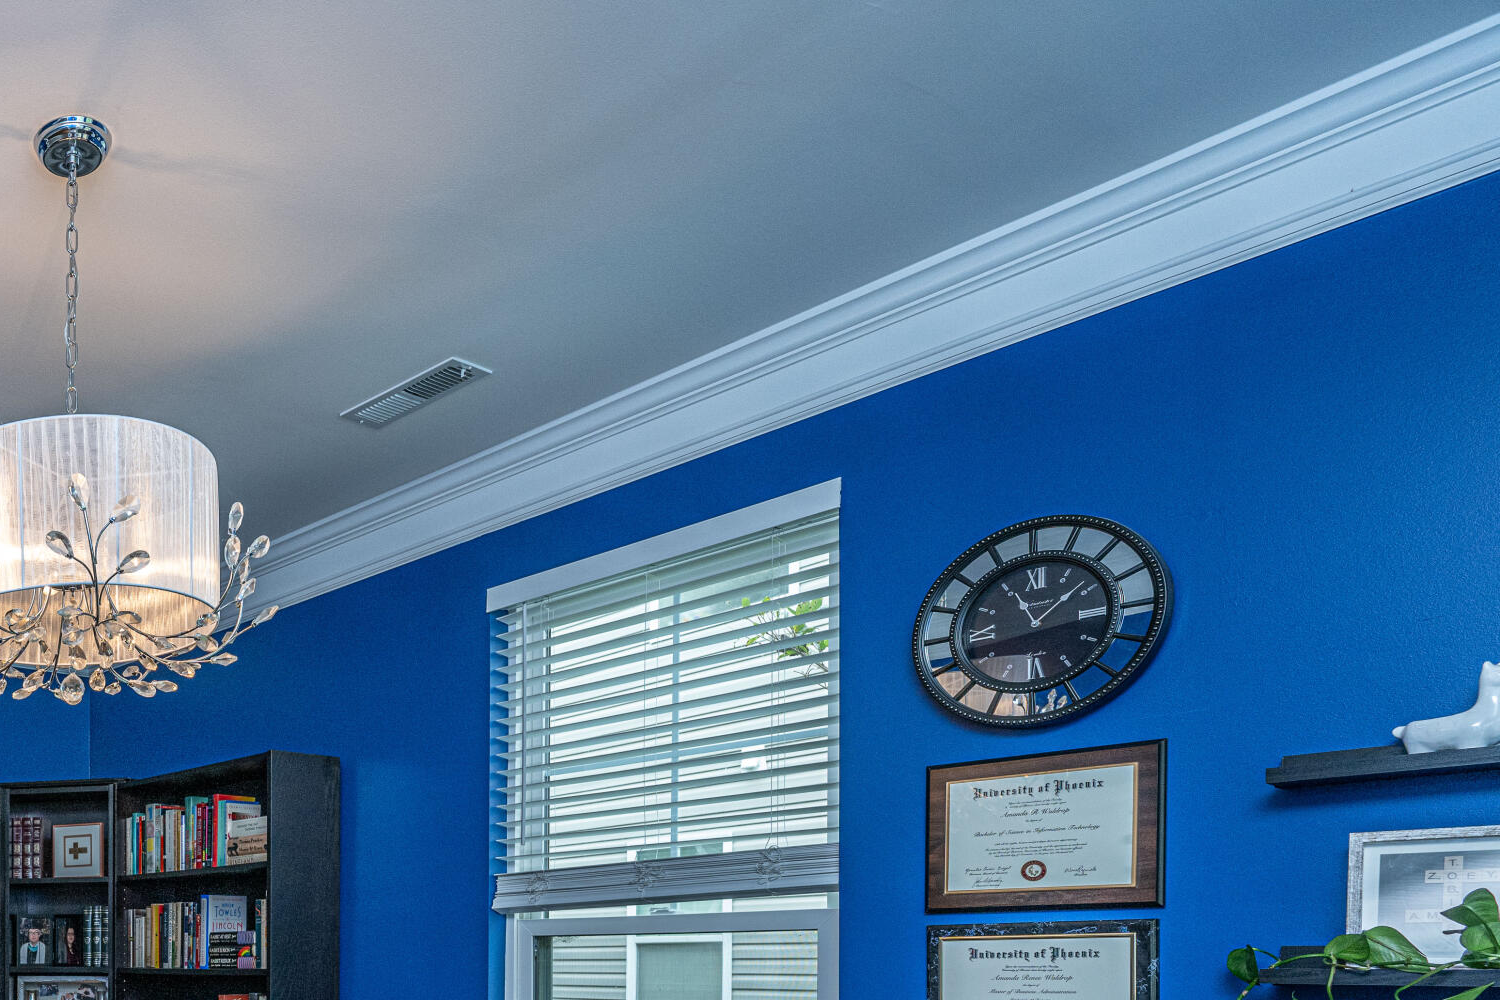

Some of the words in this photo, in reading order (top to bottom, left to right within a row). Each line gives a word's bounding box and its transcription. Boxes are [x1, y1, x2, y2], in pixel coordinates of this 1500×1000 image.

[1025, 566, 1048, 591] XII
[972, 786, 1034, 801] University
[1038, 782, 1051, 793] of
[1053, 779, 1105, 797] Phoenix
[213, 904, 241, 918] TOWLES
[212, 920, 243, 932] LINCOLN
[968, 947, 1031, 963] University
[1033, 948, 1047, 959] of
[1048, 946, 1101, 964] Phoenix
